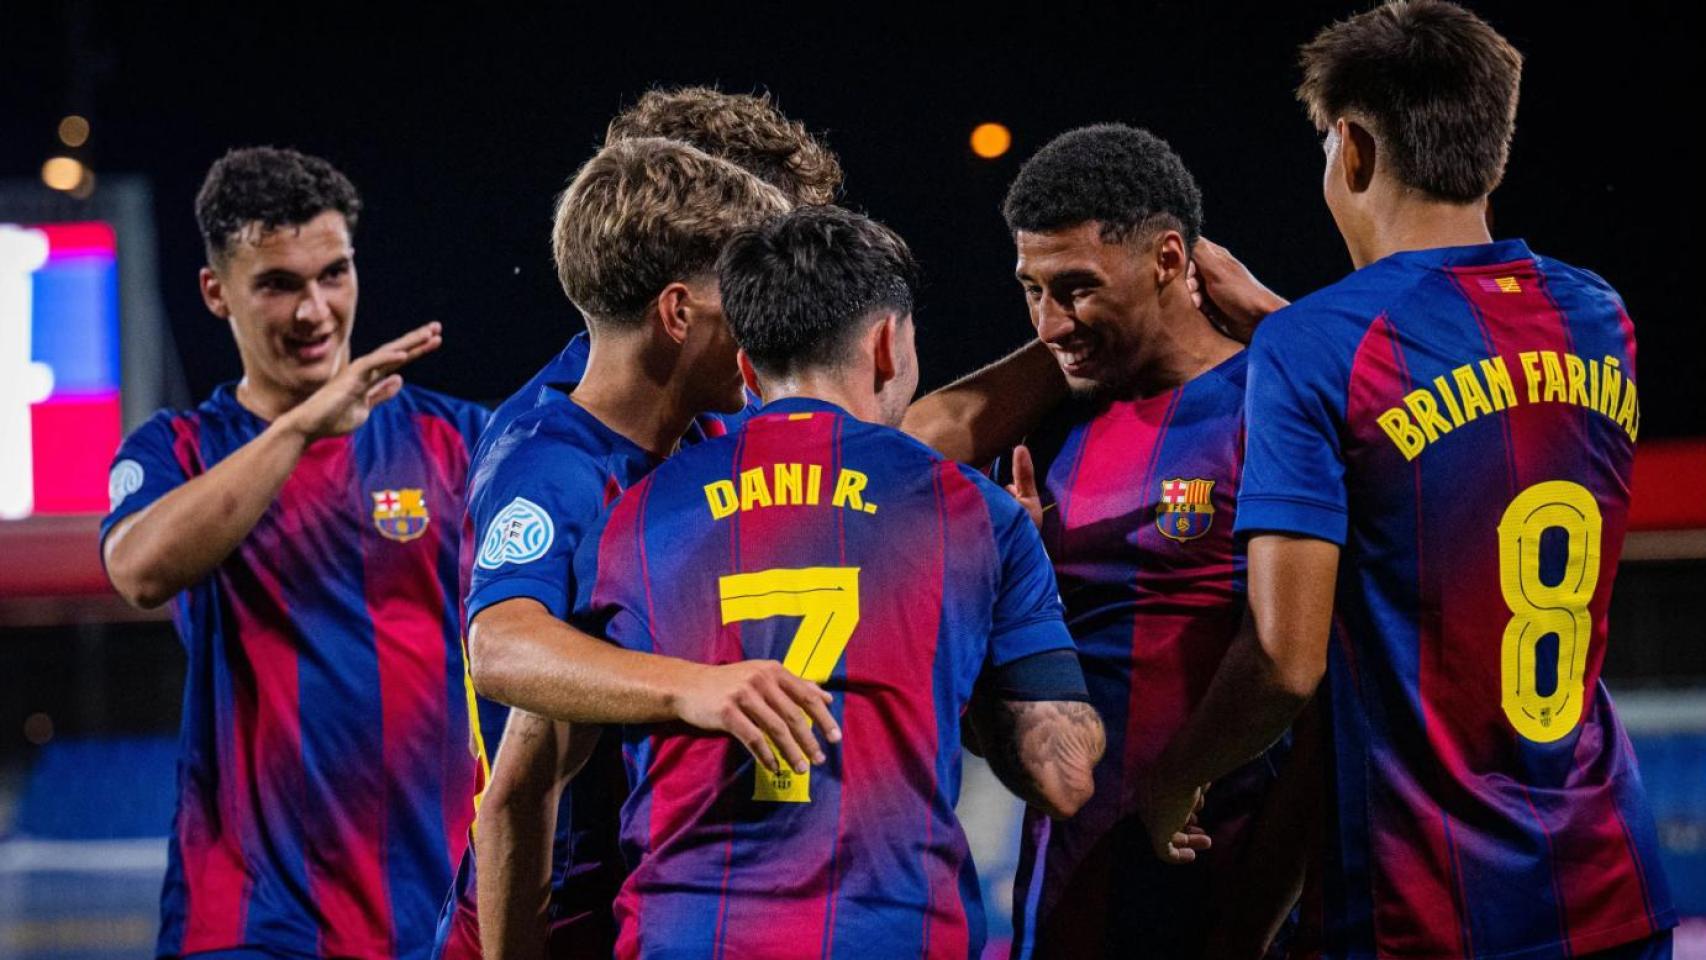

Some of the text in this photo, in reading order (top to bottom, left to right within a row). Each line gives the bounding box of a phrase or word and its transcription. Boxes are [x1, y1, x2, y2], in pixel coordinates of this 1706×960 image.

[704, 463, 878, 520] DANI R.
[1376, 356, 1518, 461] BRIAN
[719, 566, 861, 802] 7
[1497, 480, 1602, 743] 8
